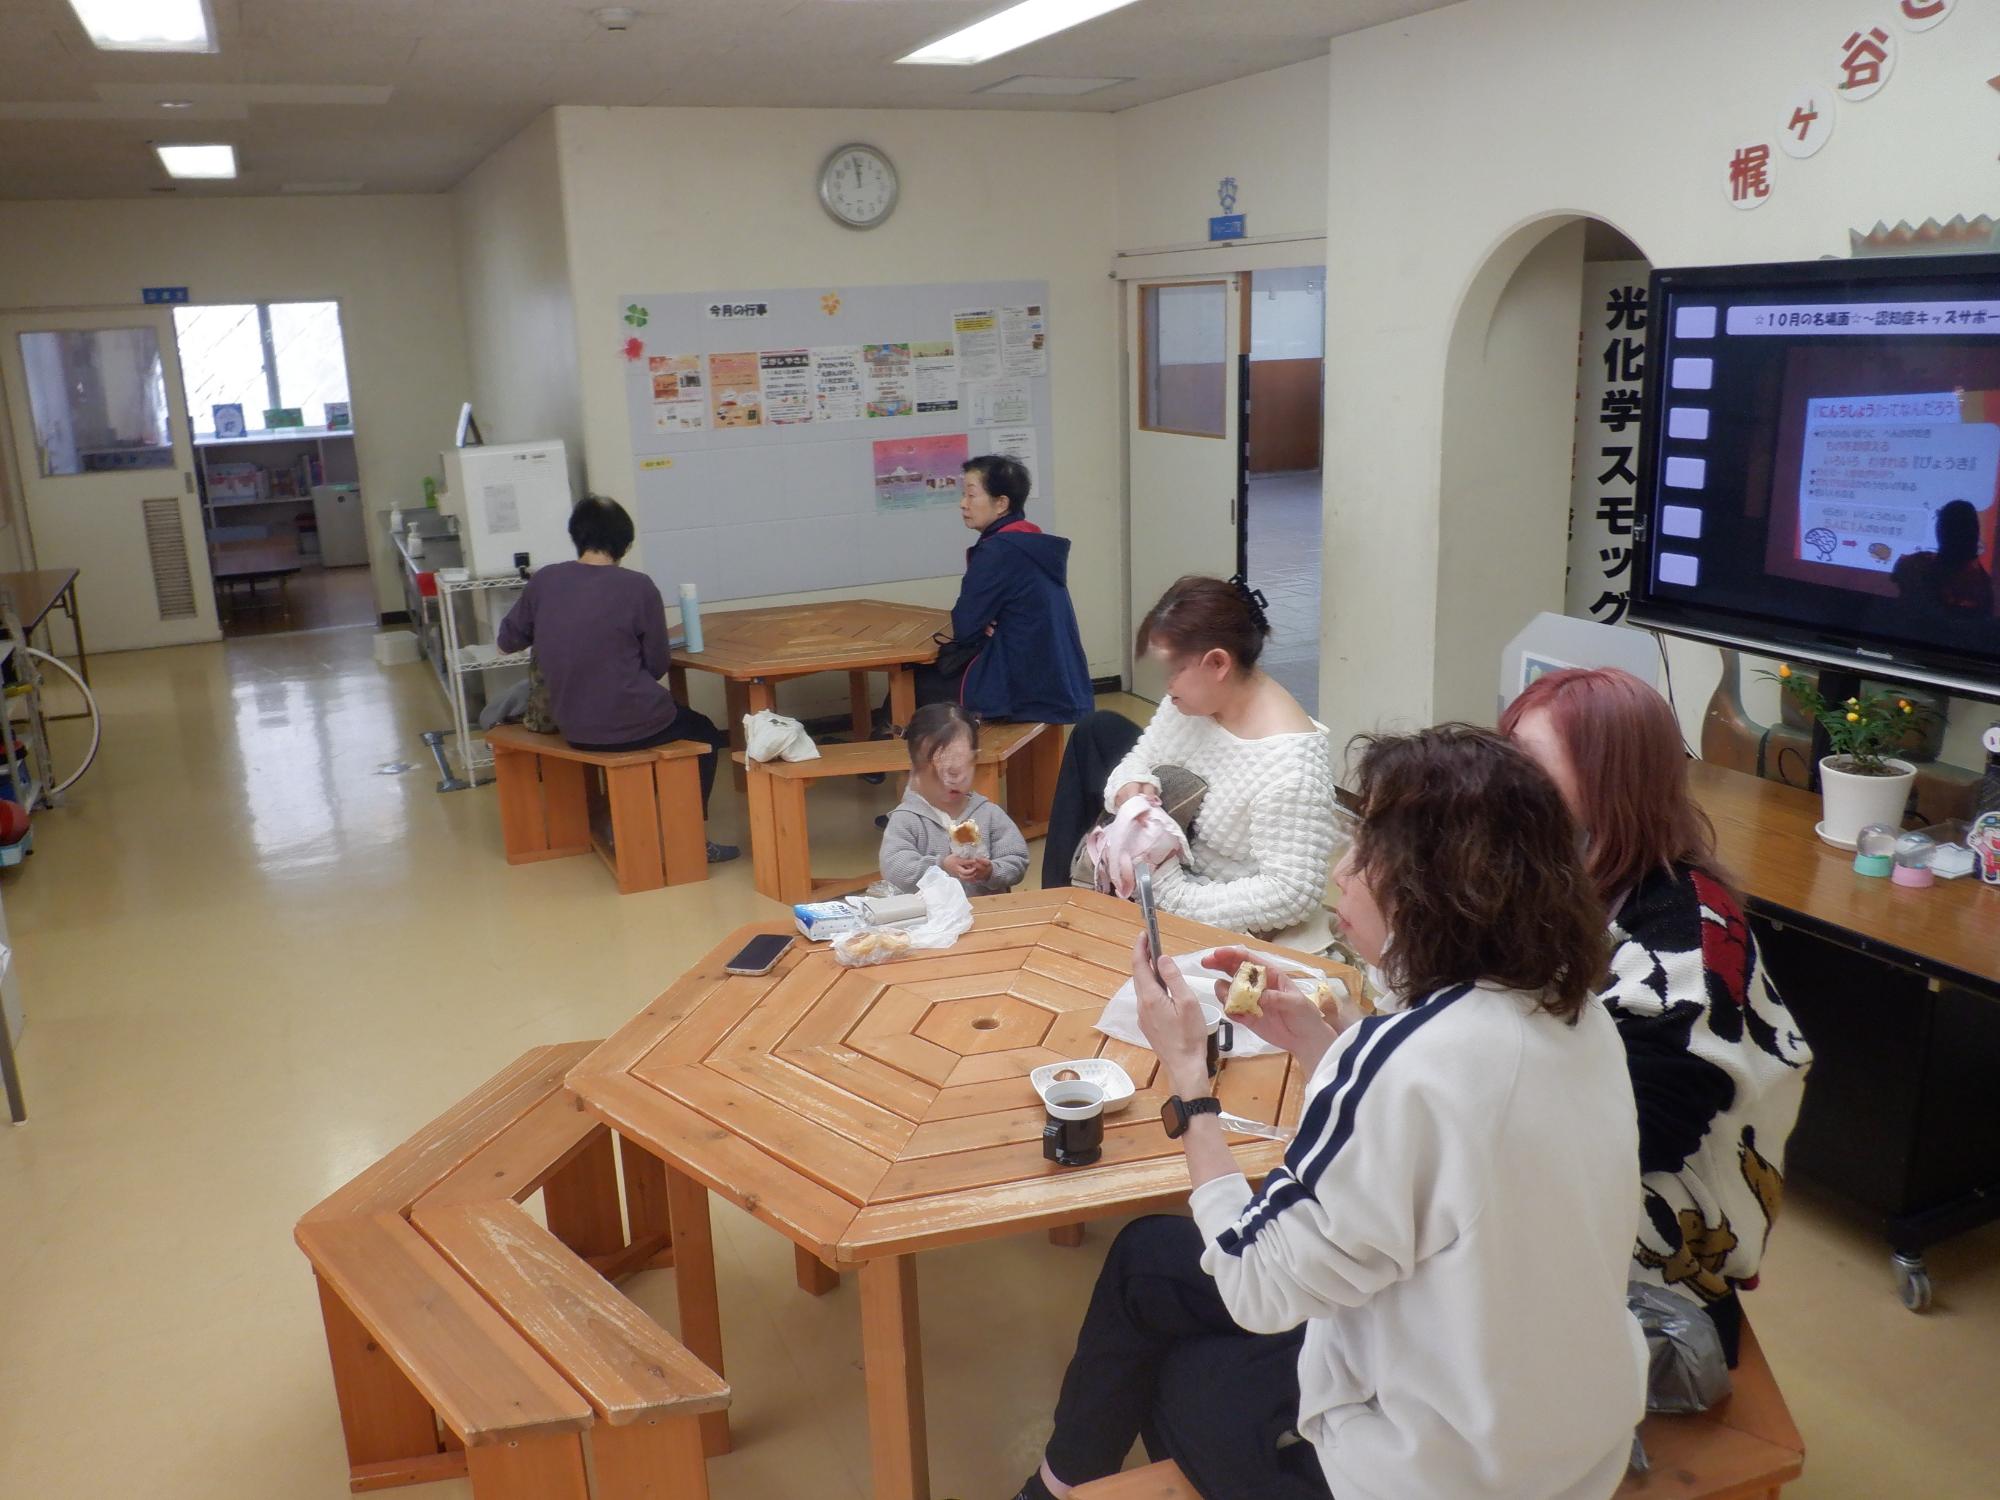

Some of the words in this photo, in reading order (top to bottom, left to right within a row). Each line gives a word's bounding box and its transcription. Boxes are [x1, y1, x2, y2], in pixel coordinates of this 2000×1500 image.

[709, 303, 768, 317] 今月の行事
[1589, 286, 1648, 625] 光化学スモッグ
